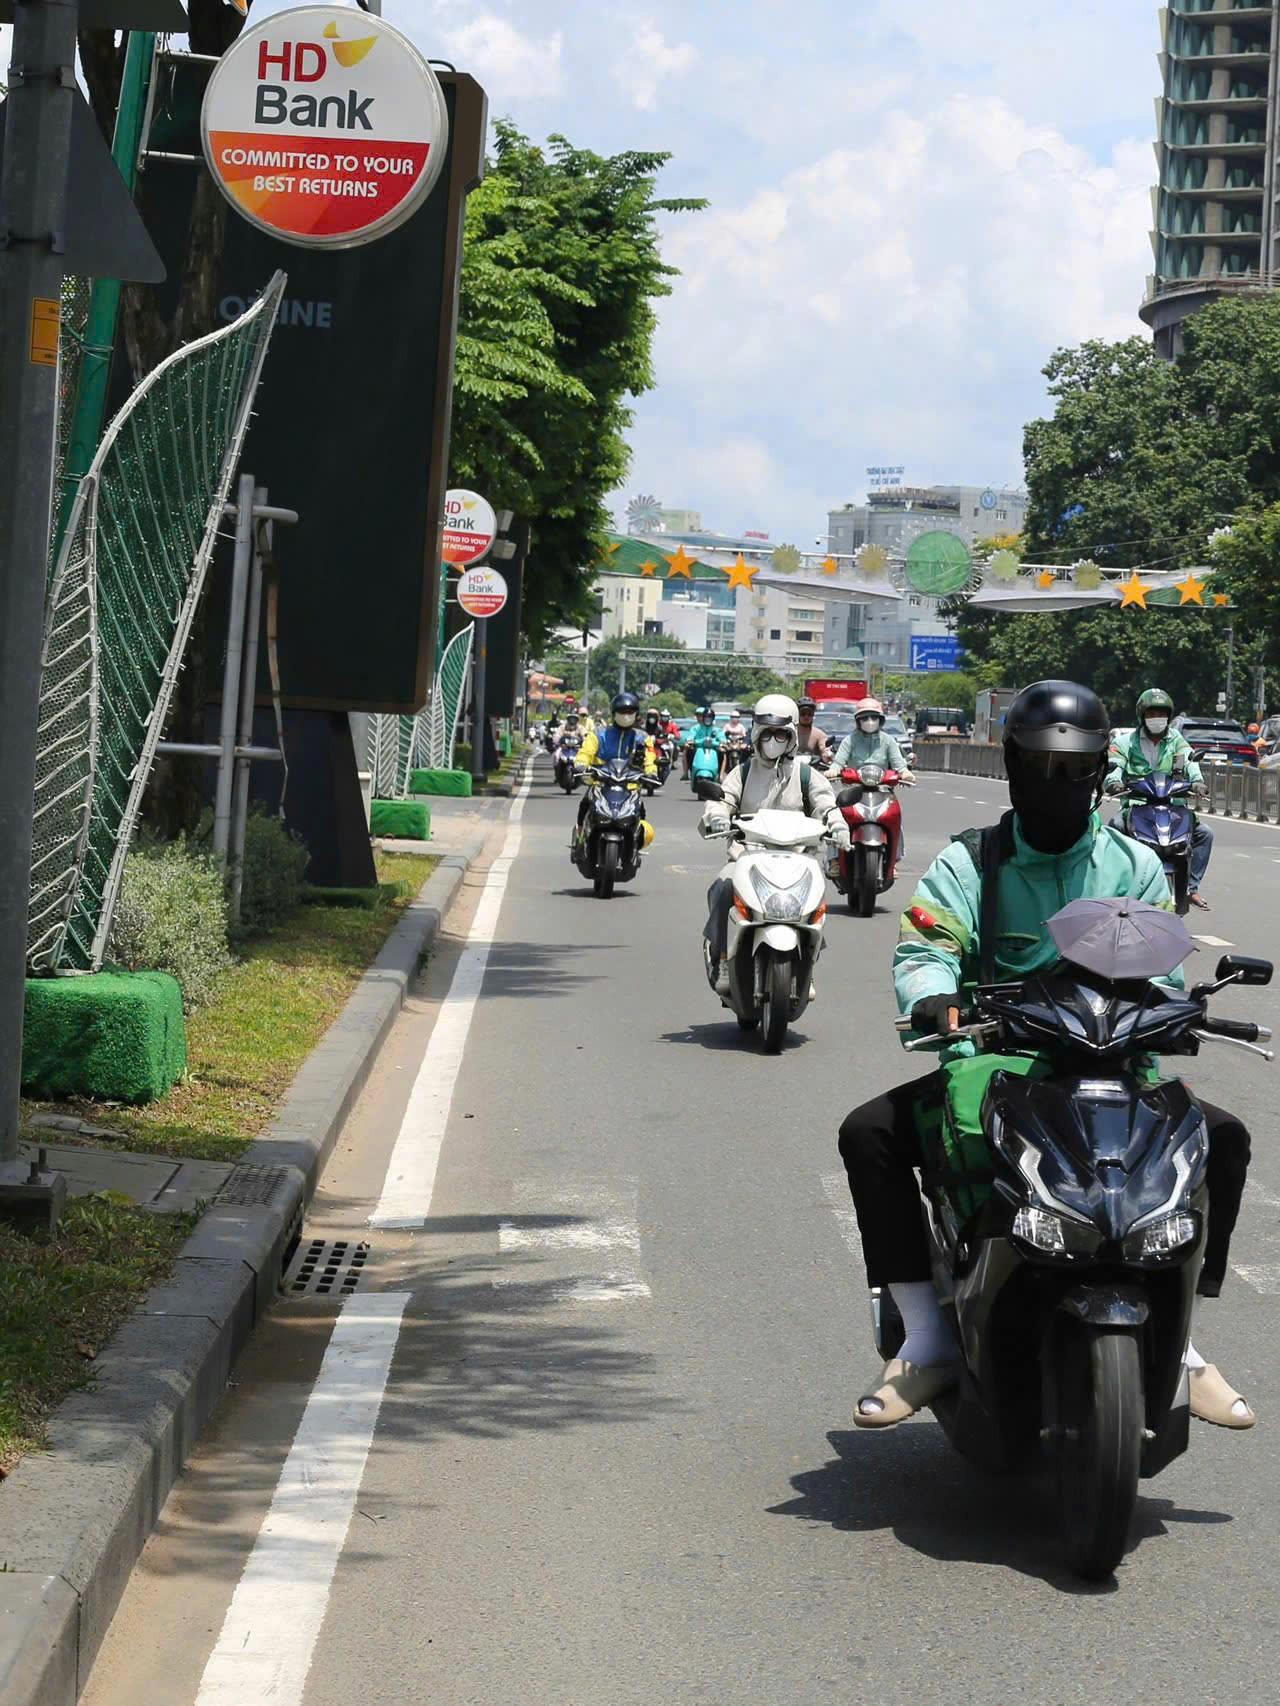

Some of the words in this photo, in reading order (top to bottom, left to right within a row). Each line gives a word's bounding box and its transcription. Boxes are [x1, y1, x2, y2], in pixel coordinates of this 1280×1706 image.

[257, 40, 327, 83] HD
[254, 84, 376, 130] Bank
[221, 148, 330, 170] COMMITTED
[334, 154, 358, 172] TO
[363, 157, 414, 175] YOUR
[253, 175, 295, 193] BEST
[299, 177, 378, 198] RETURNS
[468, 584, 494, 593] Bank
